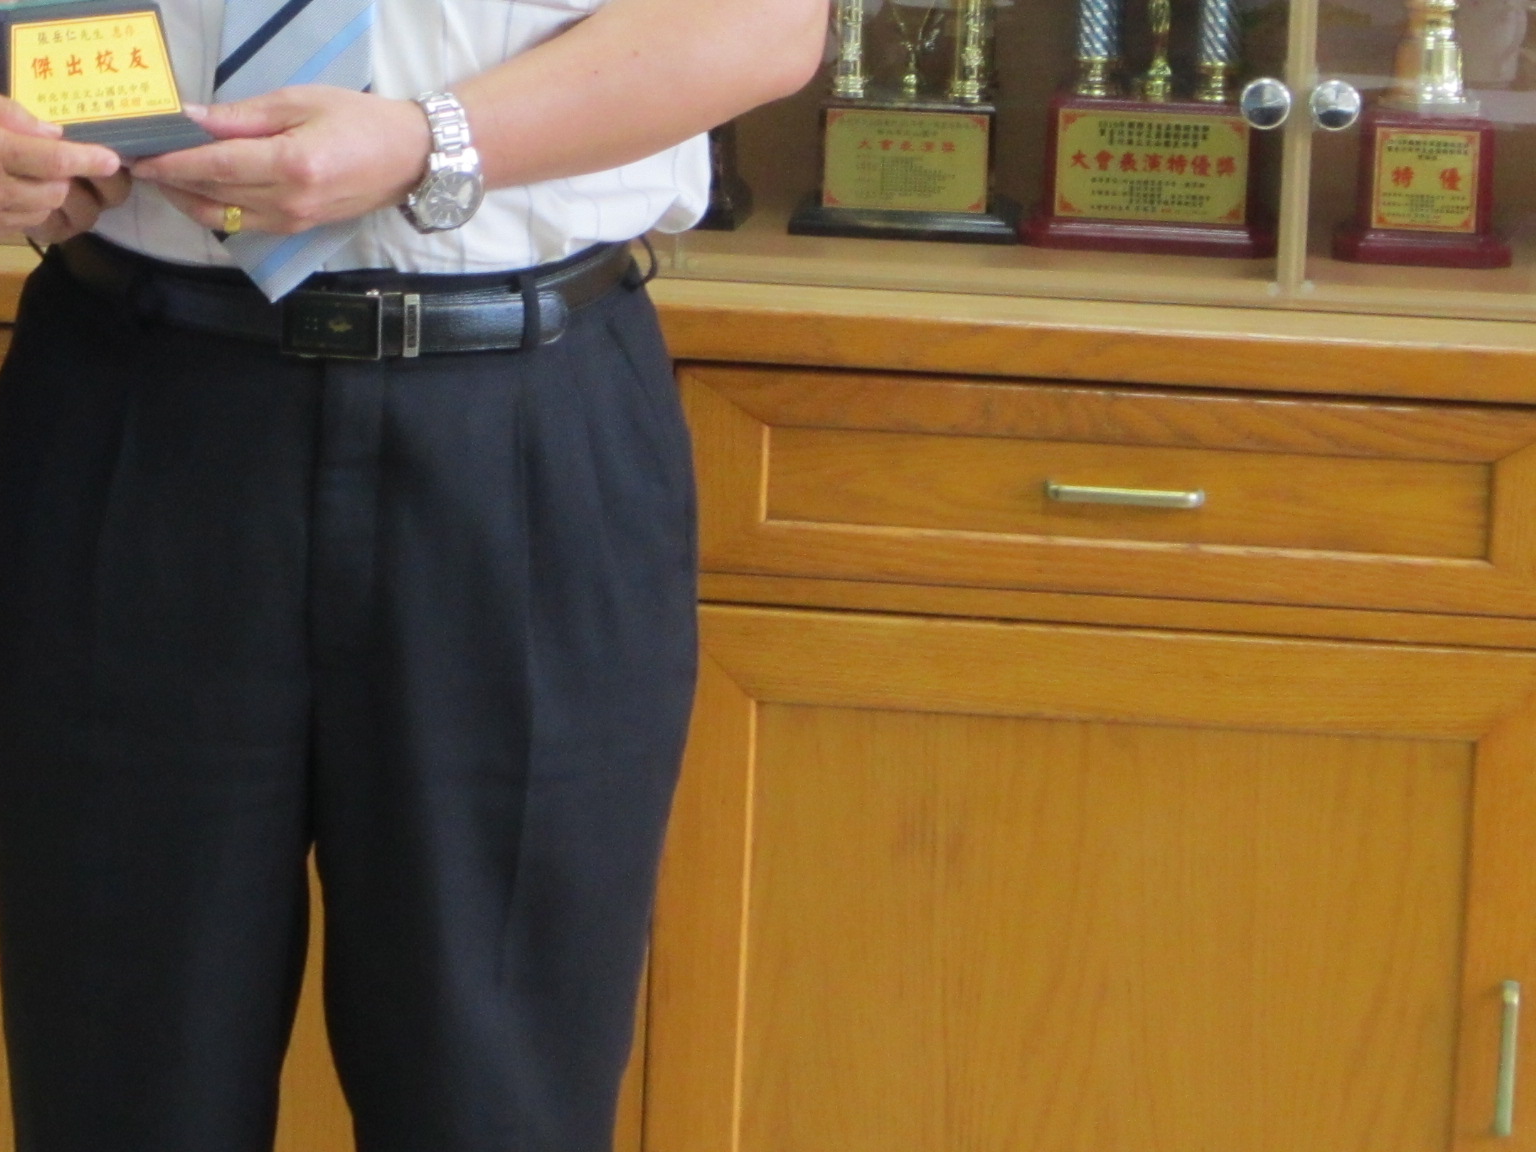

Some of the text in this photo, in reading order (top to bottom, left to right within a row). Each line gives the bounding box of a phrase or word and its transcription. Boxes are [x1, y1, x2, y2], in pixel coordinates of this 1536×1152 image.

[30, 47, 150, 80] 傑出校友
[1070, 148, 1238, 178] 大會表演特優獎
